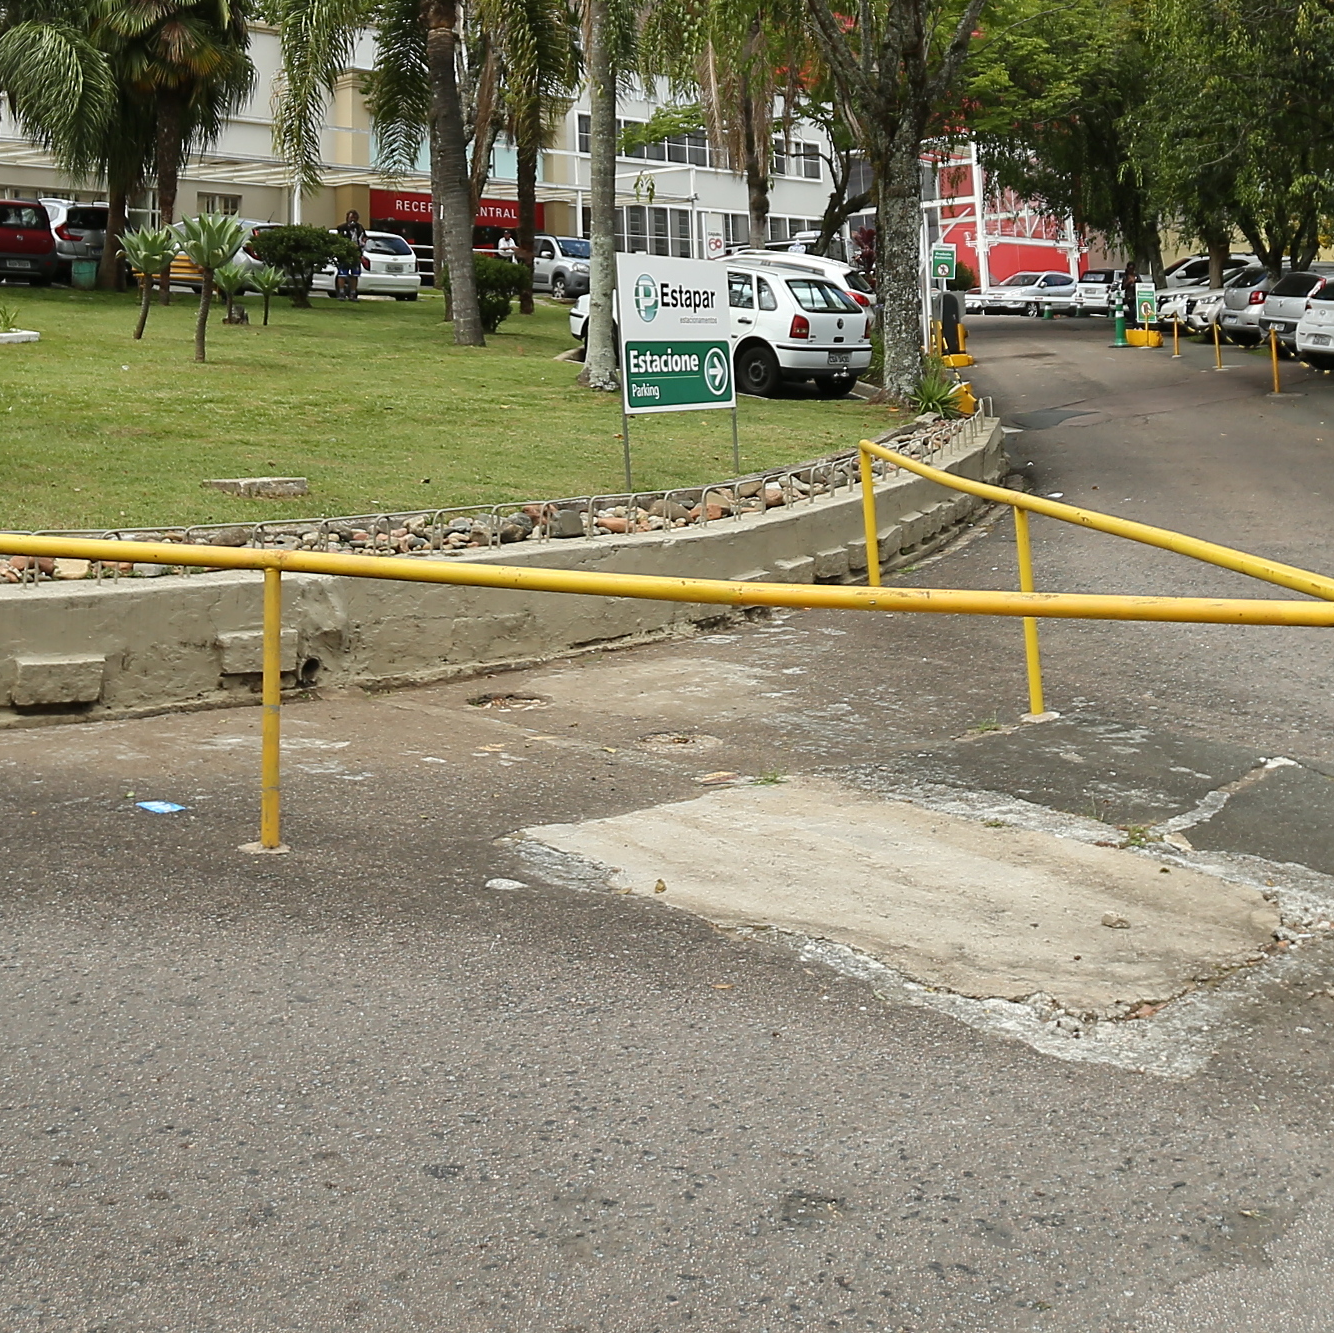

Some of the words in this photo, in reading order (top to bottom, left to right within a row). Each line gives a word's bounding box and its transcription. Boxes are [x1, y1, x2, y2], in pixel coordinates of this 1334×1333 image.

[476, 206, 518, 219] NTRAL
[660, 283, 716, 313] Estapar
[629, 348, 700, 373] Estacione
[632, 383, 660, 399] Parking
